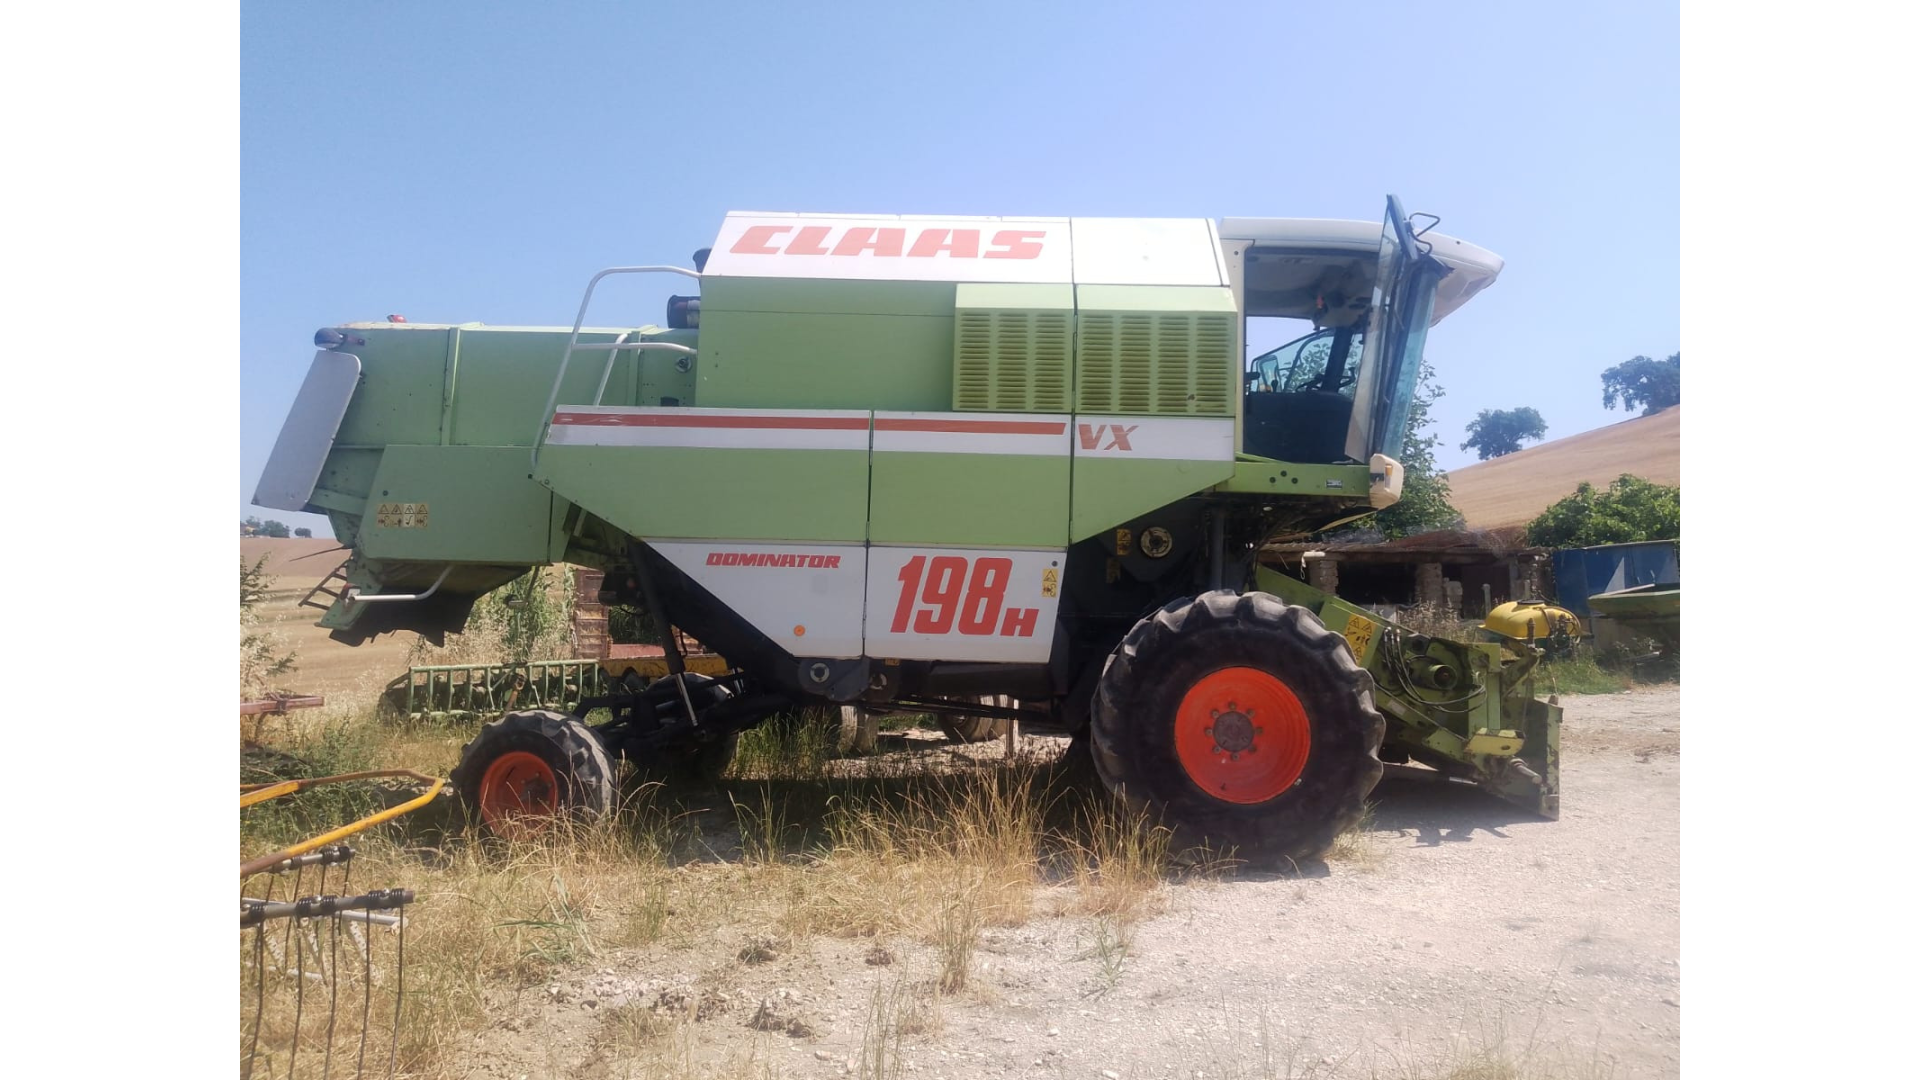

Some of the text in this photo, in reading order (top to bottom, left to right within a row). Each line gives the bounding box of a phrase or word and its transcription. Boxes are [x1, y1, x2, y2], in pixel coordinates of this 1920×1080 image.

[729, 225, 1046, 260] CLAAS
[1077, 424, 1138, 451] VX
[706, 552, 841, 569] DOMINATOR
